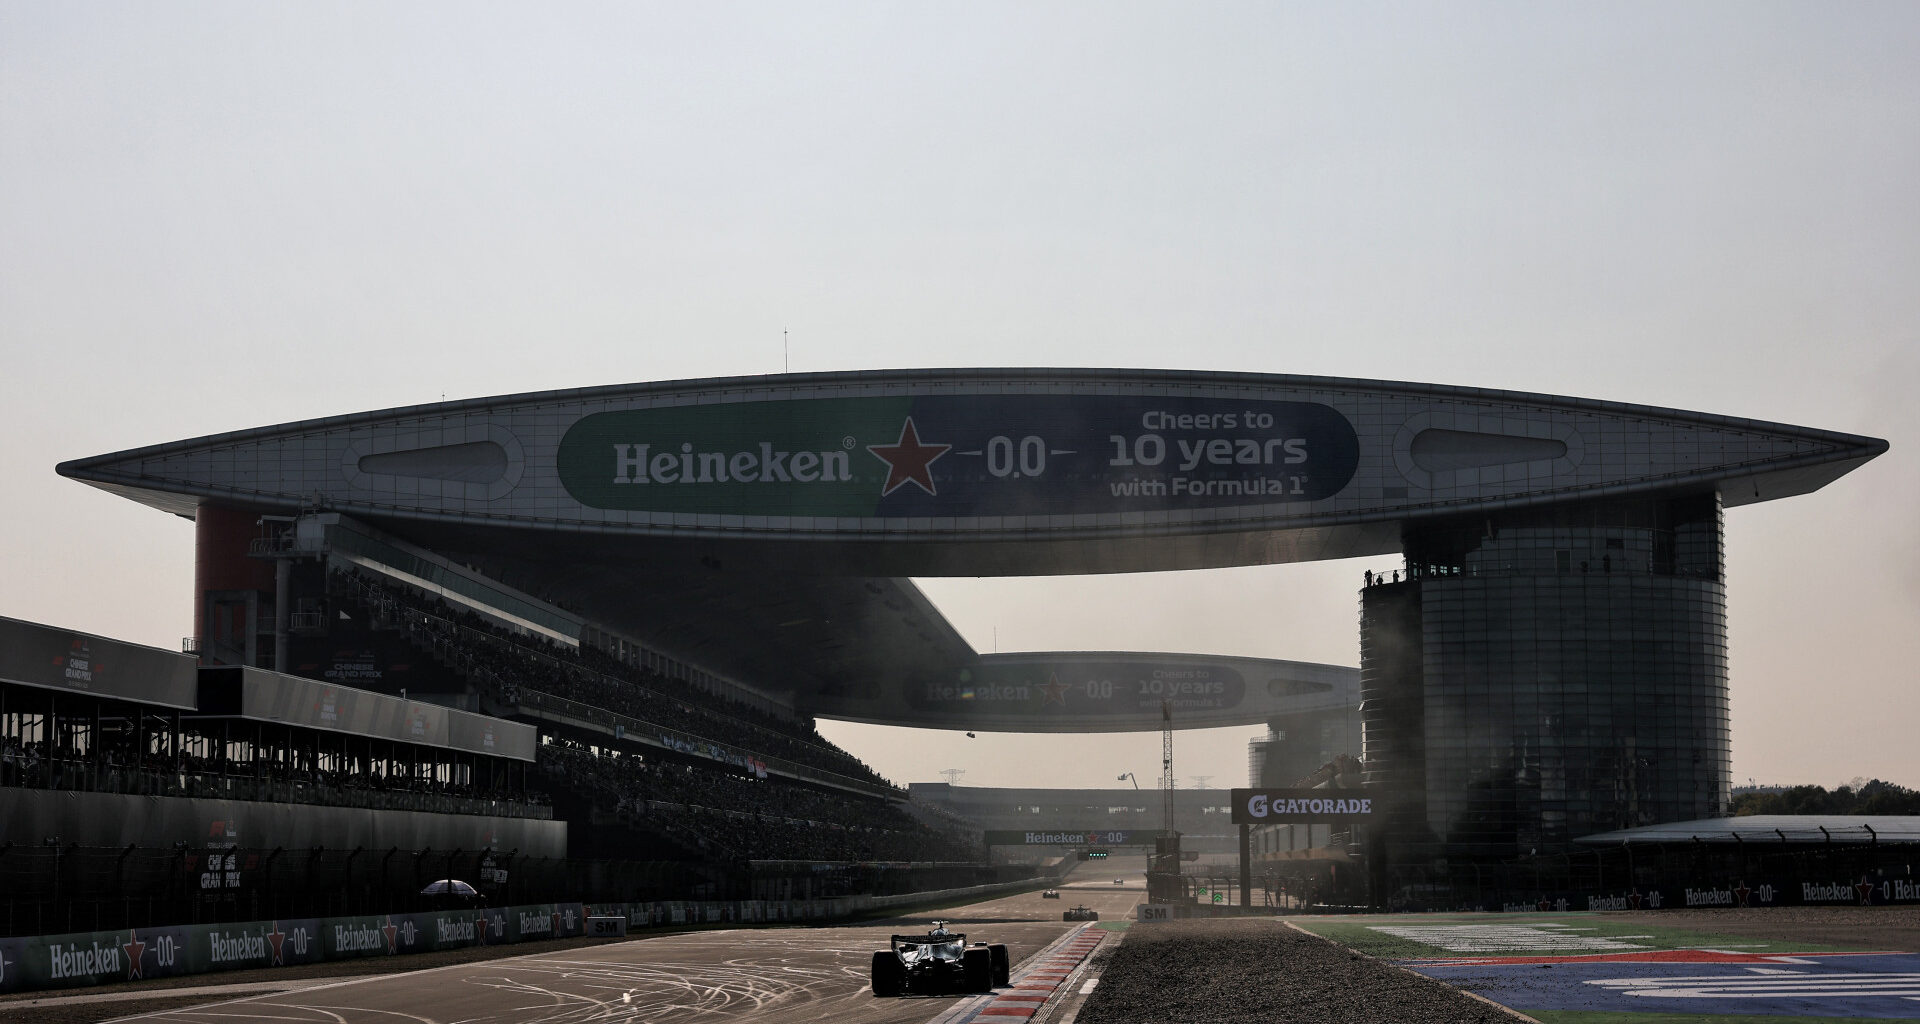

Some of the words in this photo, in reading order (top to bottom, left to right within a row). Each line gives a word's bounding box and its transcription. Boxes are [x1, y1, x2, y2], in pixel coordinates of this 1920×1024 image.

[1142, 411, 1238, 430] Cheers
[1244, 411, 1274, 429] to
[987, 436, 1047, 478] 0.0
[1109, 434, 1167, 466] 10
[1177, 438, 1308, 471] years
[1110, 479, 1167, 497] with
[1172, 477, 1283, 496] Formula
[334, 663, 375, 671] CHINESE
[1139, 679, 1164, 694] 10
[1169, 680, 1224, 697] years
[1272, 799, 1371, 814] GATORADE
[1025, 832, 1084, 844] Heineken
[1685, 886, 1733, 905] Heineken
[1760, 884, 1772, 902] 0.0
[1802, 881, 1854, 901] Heineken
[1588, 893, 1627, 910] Heineken
[519, 910, 551, 934] Heineken
[1144, 908, 1167, 919] SM
[335, 921, 382, 951] Heineken
[437, 915, 475, 942] Heineken
[595, 922, 618, 933] SM
[157, 935, 174, 967] 0.0
[209, 931, 266, 961] Heineken
[294, 927, 307, 955] 0.0
